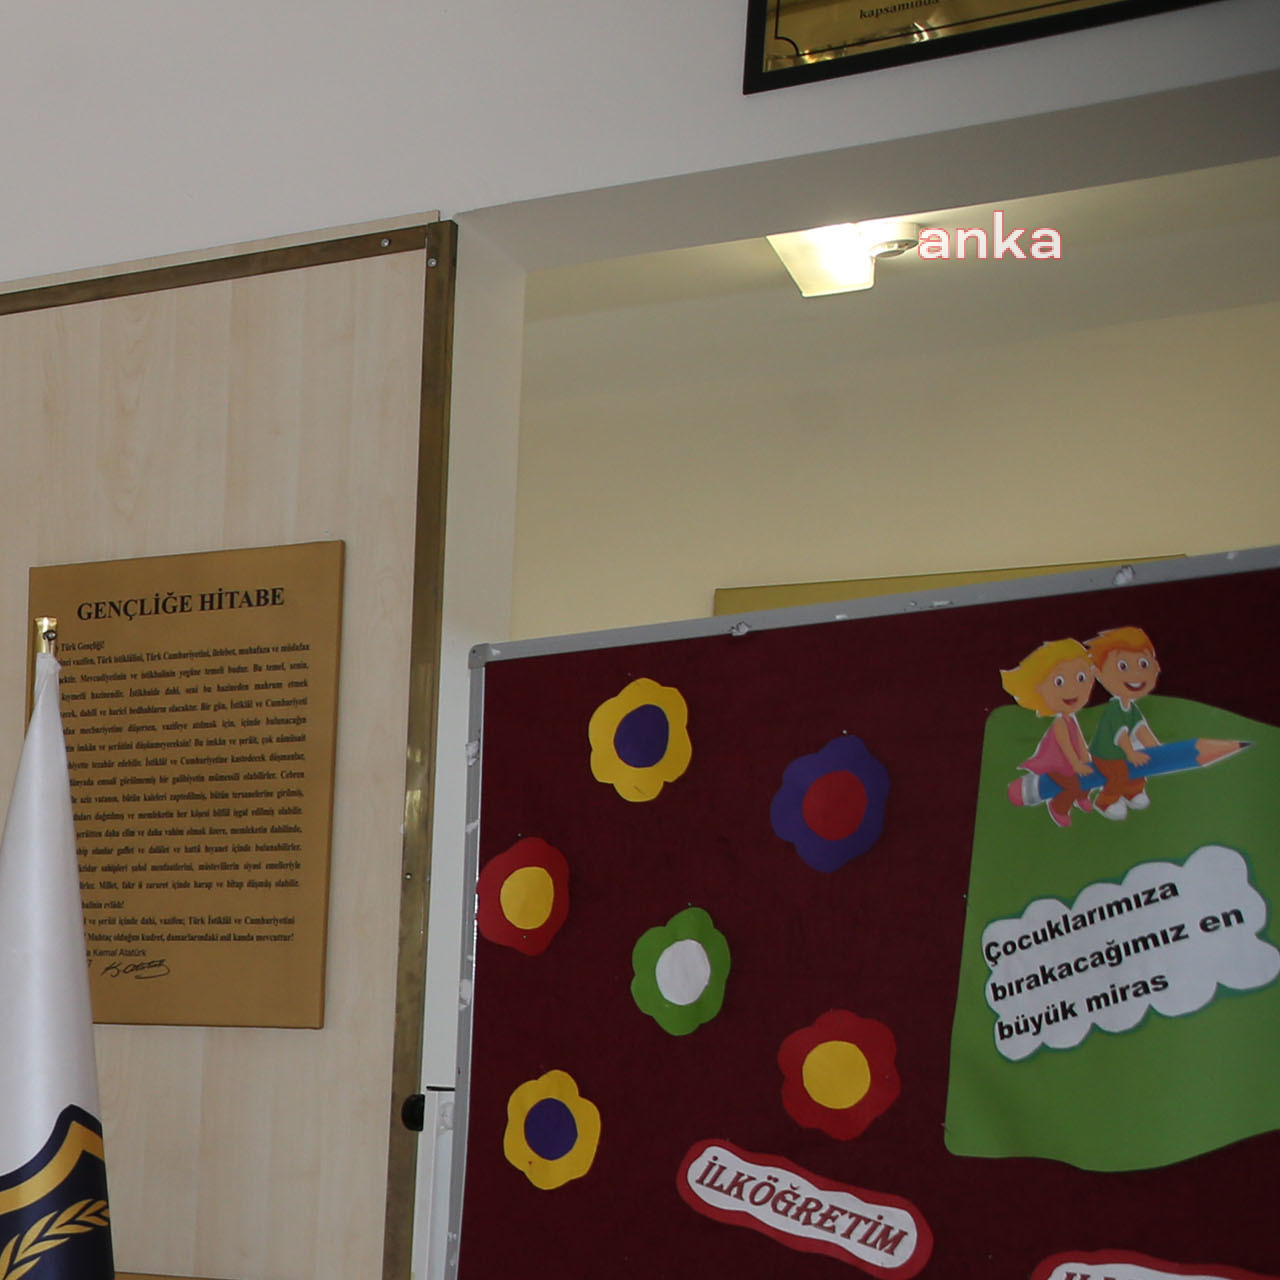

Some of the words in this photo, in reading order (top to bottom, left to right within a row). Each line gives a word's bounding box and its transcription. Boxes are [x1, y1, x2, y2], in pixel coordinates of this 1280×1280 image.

[77, 592, 192, 621] GENÇLİĞE
[200, 587, 284, 611] HİTABE
[985, 882, 1179, 966] Çocuklarımıza
[991, 922, 1189, 1002] bırakacağımız
[1199, 907, 1245, 933] en
[997, 1001, 1079, 1041] büyük
[1086, 974, 1169, 1013] miras
[696, 1155, 908, 1256] İLKÖĞRETİM
